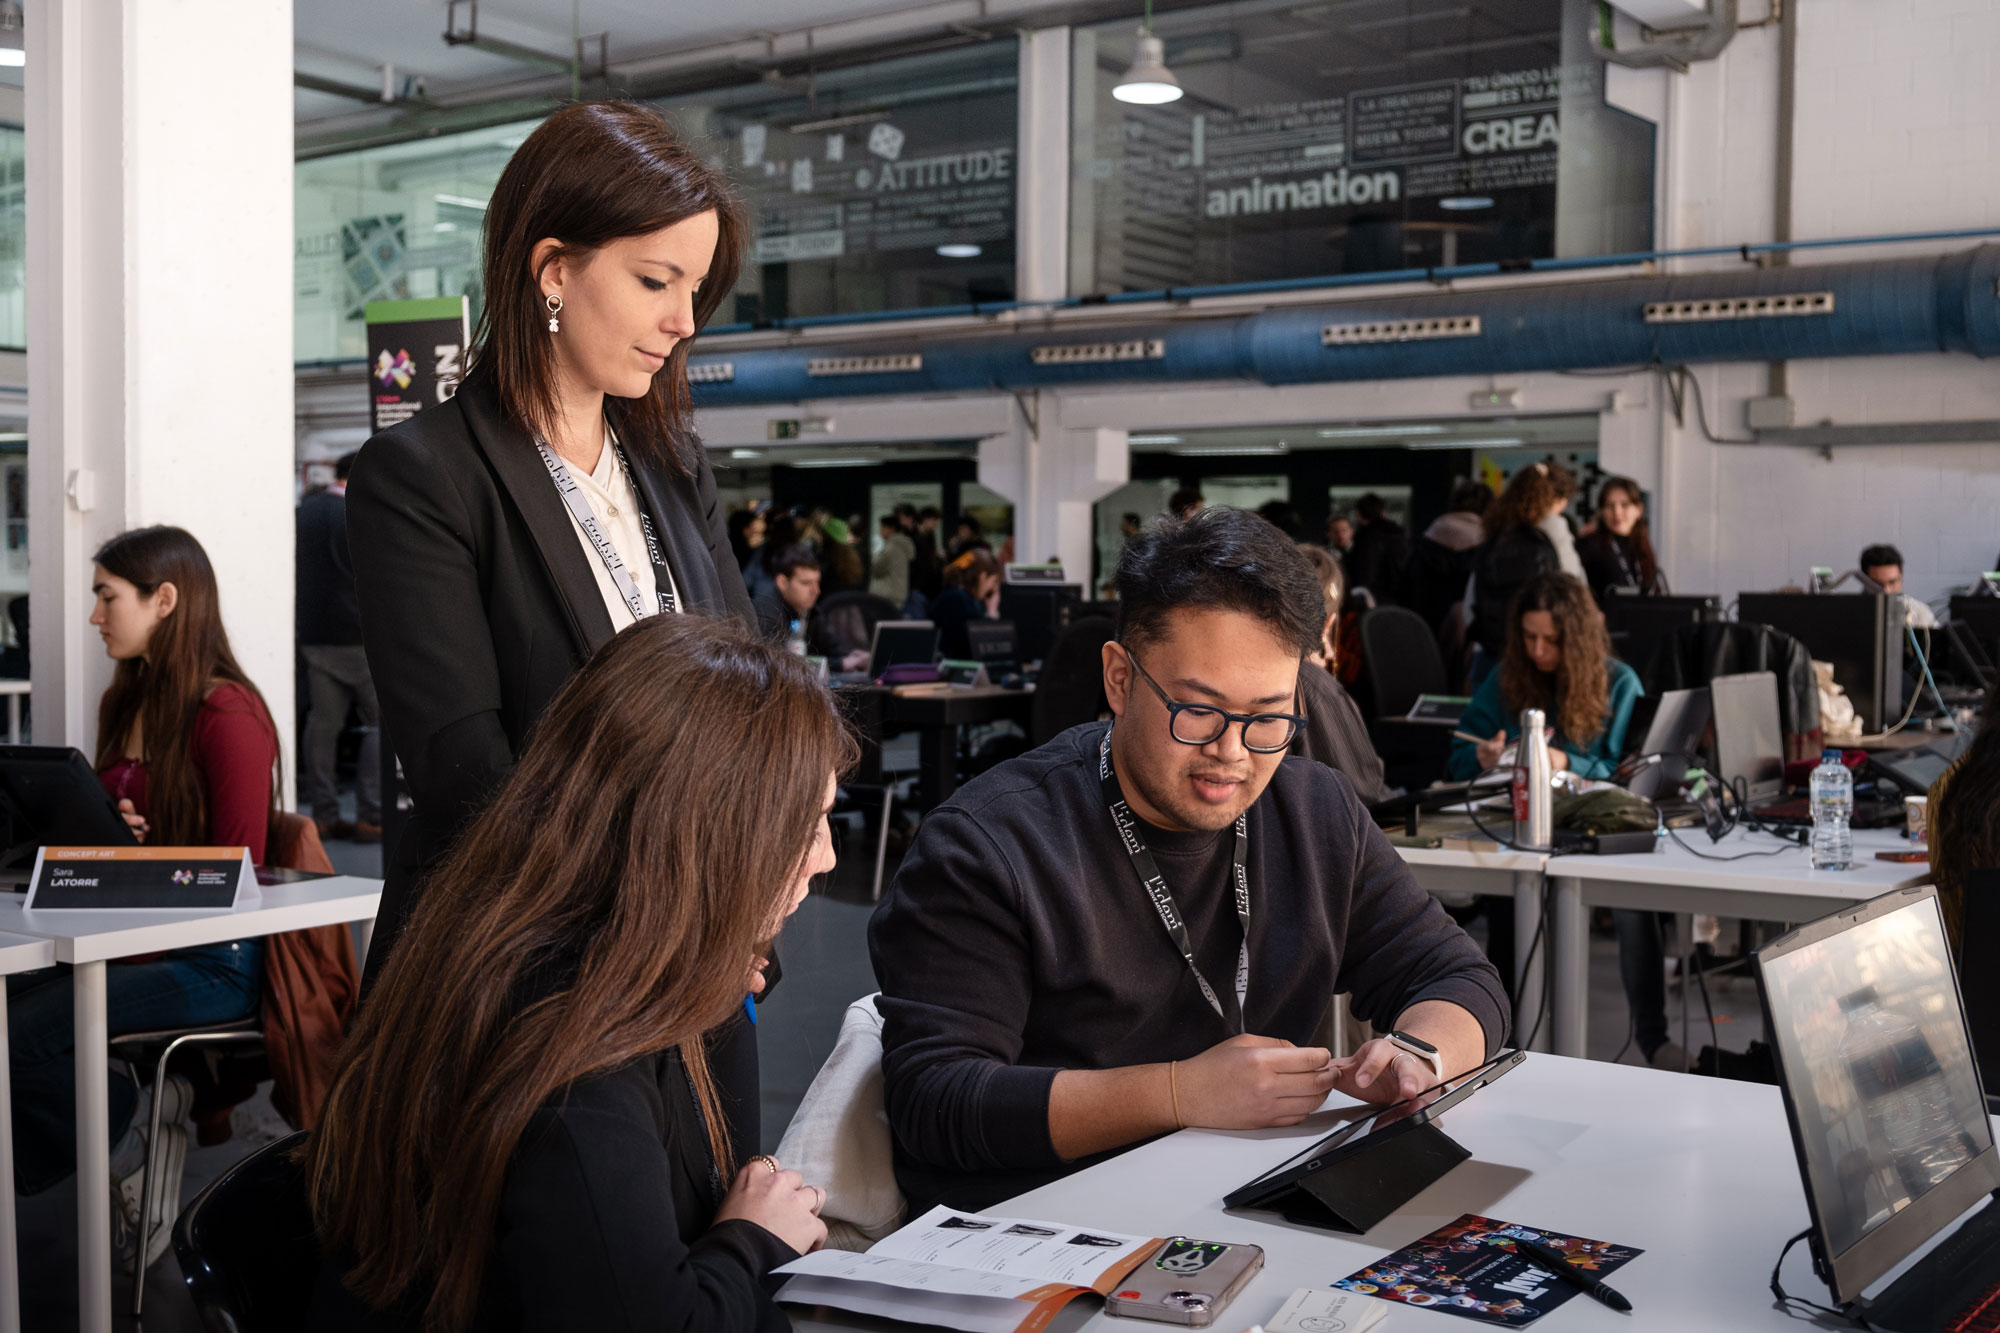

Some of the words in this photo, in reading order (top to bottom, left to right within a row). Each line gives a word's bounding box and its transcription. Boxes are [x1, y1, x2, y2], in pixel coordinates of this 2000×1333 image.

[877, 148, 1012, 191] ATTITUDE
[1206, 168, 1398, 217] animation
[57, 850, 97, 858] CONCEPT
[53, 867, 74, 877] Sara
[50, 878, 99, 887] LATORRE
